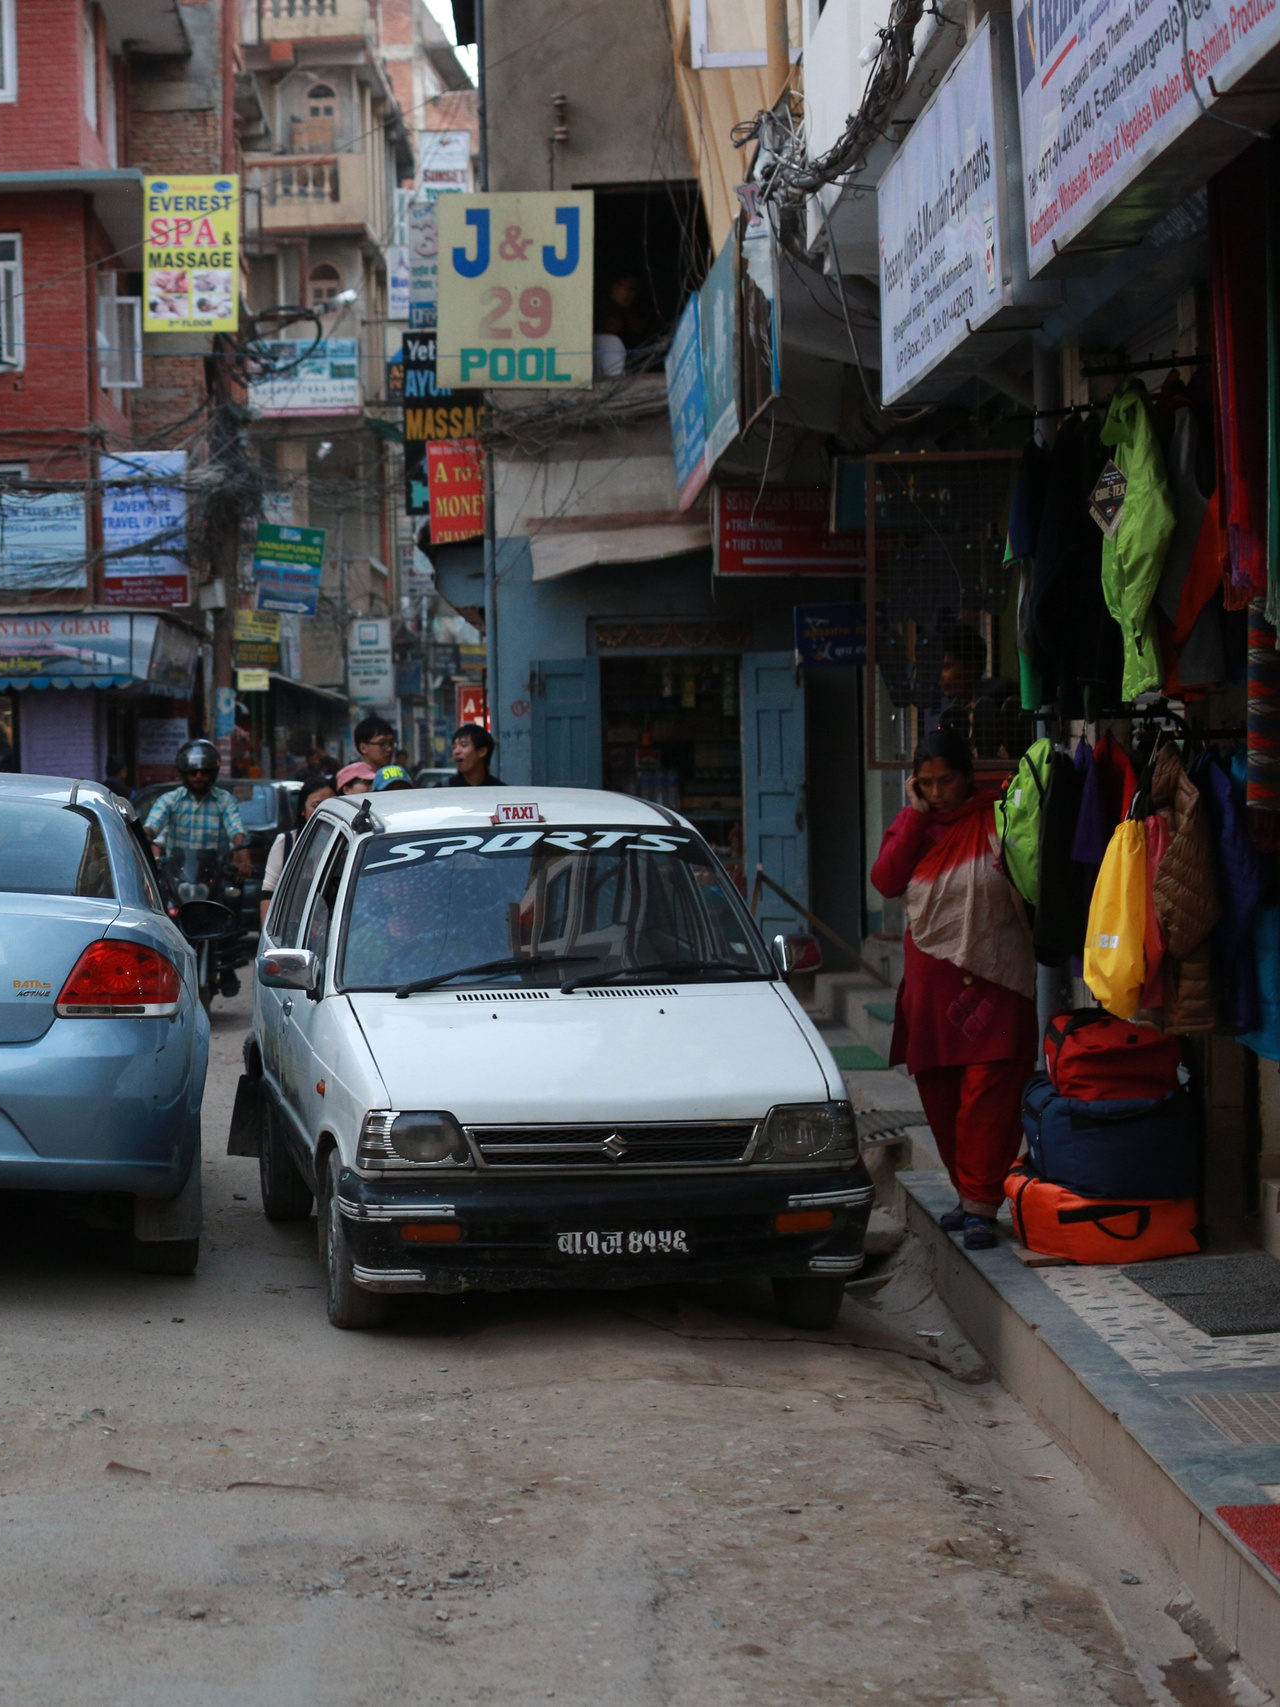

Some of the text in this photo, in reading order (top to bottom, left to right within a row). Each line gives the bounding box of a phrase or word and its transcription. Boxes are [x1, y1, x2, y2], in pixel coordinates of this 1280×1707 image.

[1088, 140, 1114, 185] Retailer
[1120, 103, 1153, 155] Nepalese
[1150, 73, 1183, 121] Woolen
[1188, 23, 1231, 80] Pashmina
[423, 169, 467, 183] SUNSET
[149, 195, 233, 212] EVEREST
[917, 210, 923, 255] &
[923, 180, 950, 249] Mountain
[950, 134, 991, 223] Equipments
[150, 217, 232, 247] SPA &
[452, 208, 490, 278] J
[498, 225, 534, 261] &
[542, 206, 580, 277] J
[148, 252, 233, 268] MASSAGE
[934, 245, 946, 270] Rent
[478, 286, 553, 339] 29
[407, 339, 437, 362] Yet
[460, 347, 572, 382] POOL
[434, 462, 448, 484] A
[452, 466, 473, 483] TO
[103, 516, 140, 529] TRAVEL
[142, 516, 156, 529] (P)
[732, 538, 757, 550] TIBET
[759, 538, 783, 550] TOUR
[61, 619, 111, 635] GEAR
[464, 698, 476, 713] A
[502, 807, 534, 820] TAXI
[365, 831, 691, 870] SPORTS
